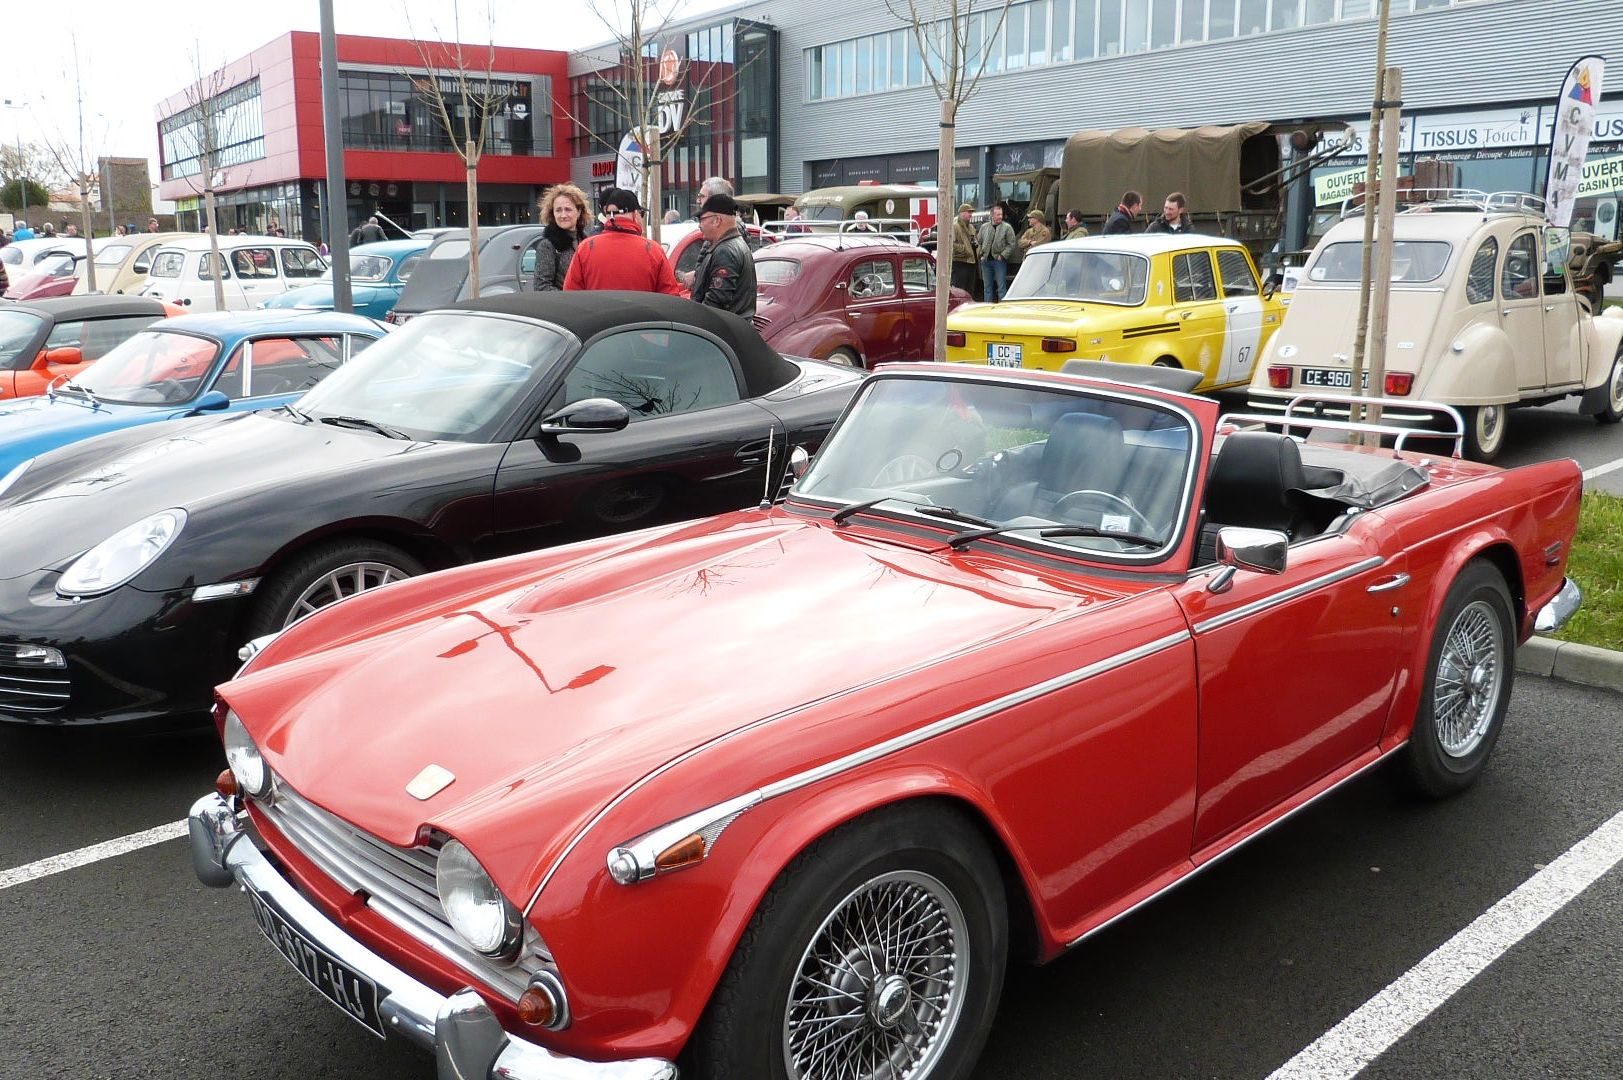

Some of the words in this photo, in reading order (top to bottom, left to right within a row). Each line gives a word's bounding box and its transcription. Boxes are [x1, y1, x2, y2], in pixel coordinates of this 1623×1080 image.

[1421, 129, 1478, 147] TISSUS
[1483, 125, 1527, 145] Touch
[1582, 160, 1623, 179] UVERT
[1578, 178, 1609, 193] GASIN
[1320, 187, 1354, 202] MAGASIN
[1238, 346, 1251, 363] 67
